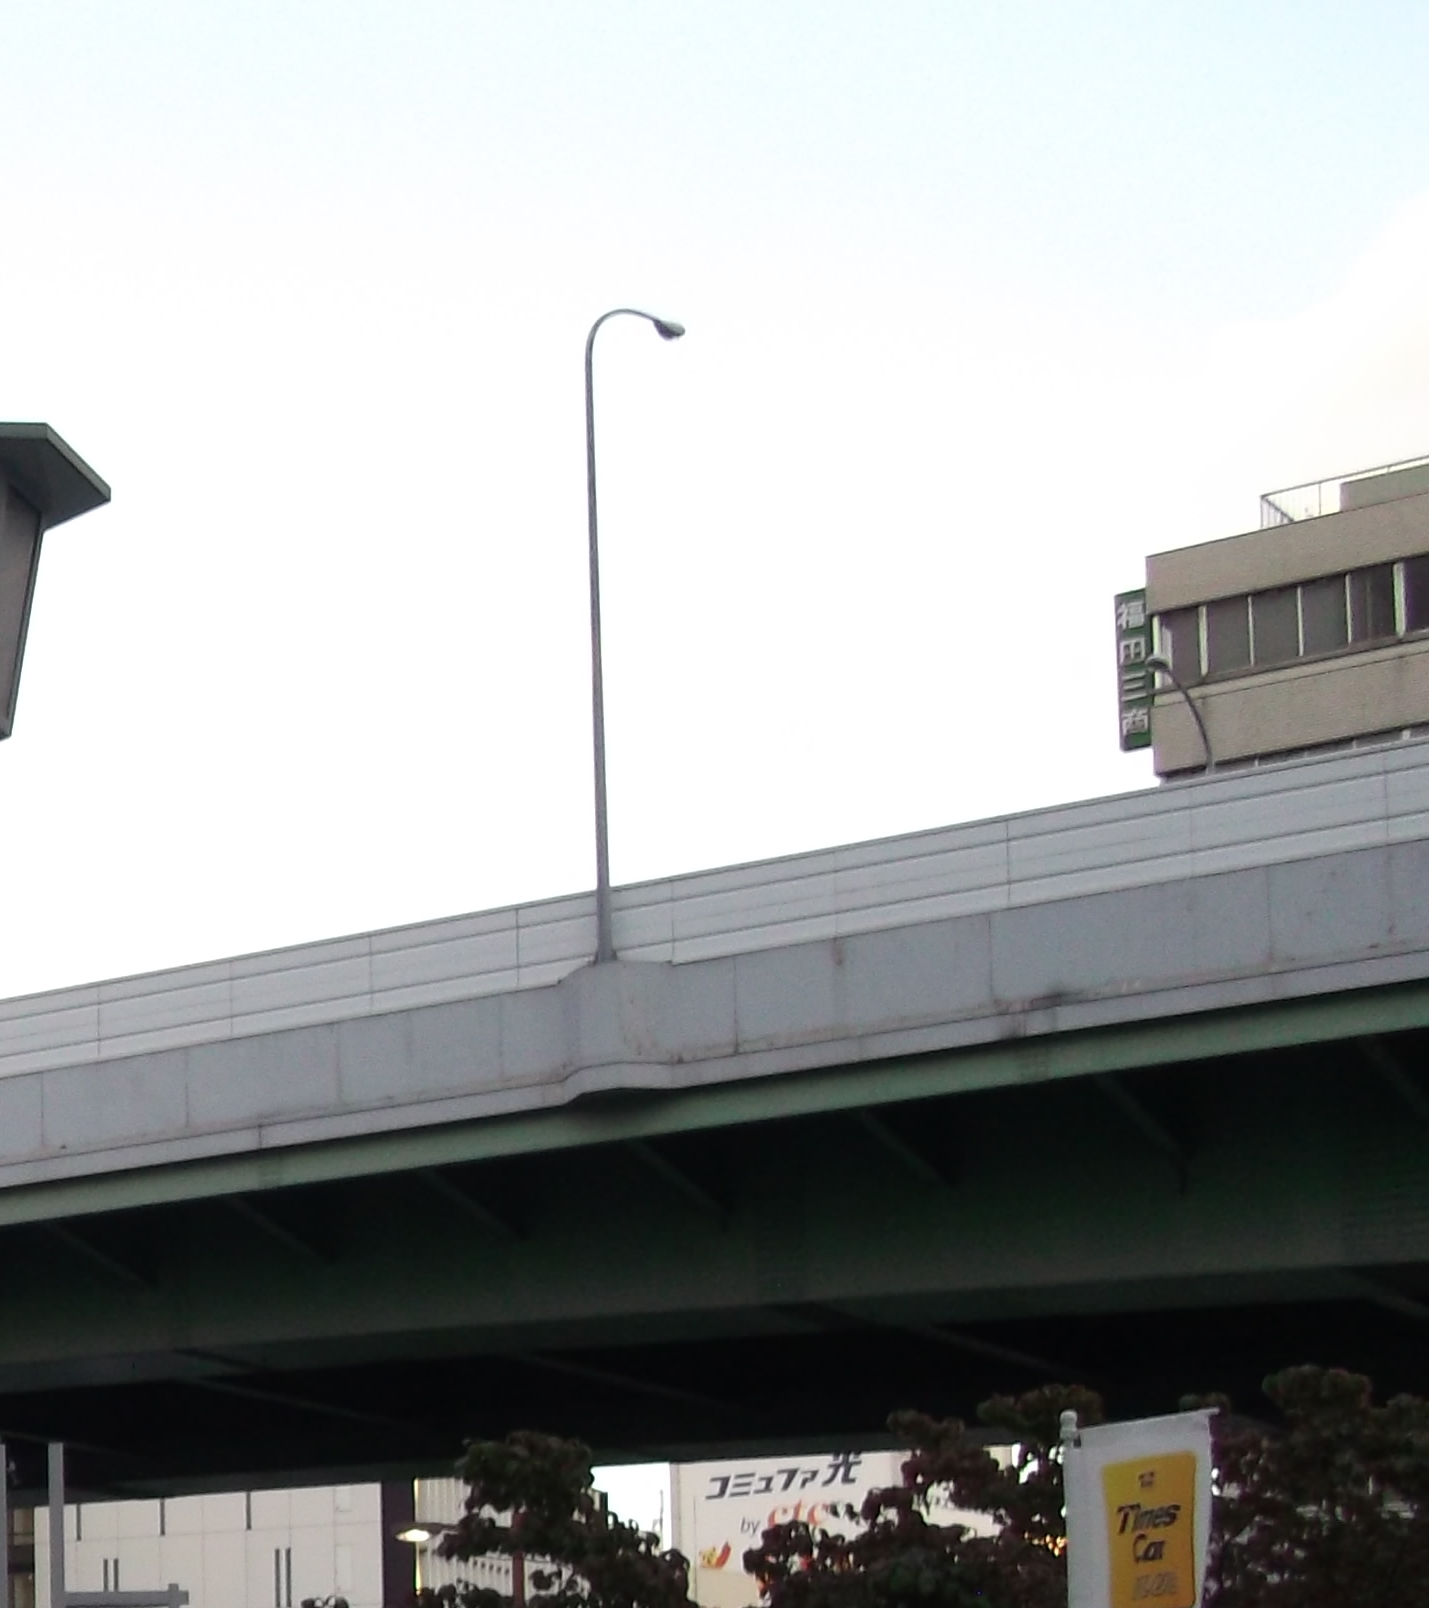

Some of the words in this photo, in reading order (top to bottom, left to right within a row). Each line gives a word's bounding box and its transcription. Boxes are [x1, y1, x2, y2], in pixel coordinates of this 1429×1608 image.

[705, 1451, 863, 1500] コミュファ光
[741, 1516, 760, 1537] by
[1116, 1502, 1181, 1536] Times
